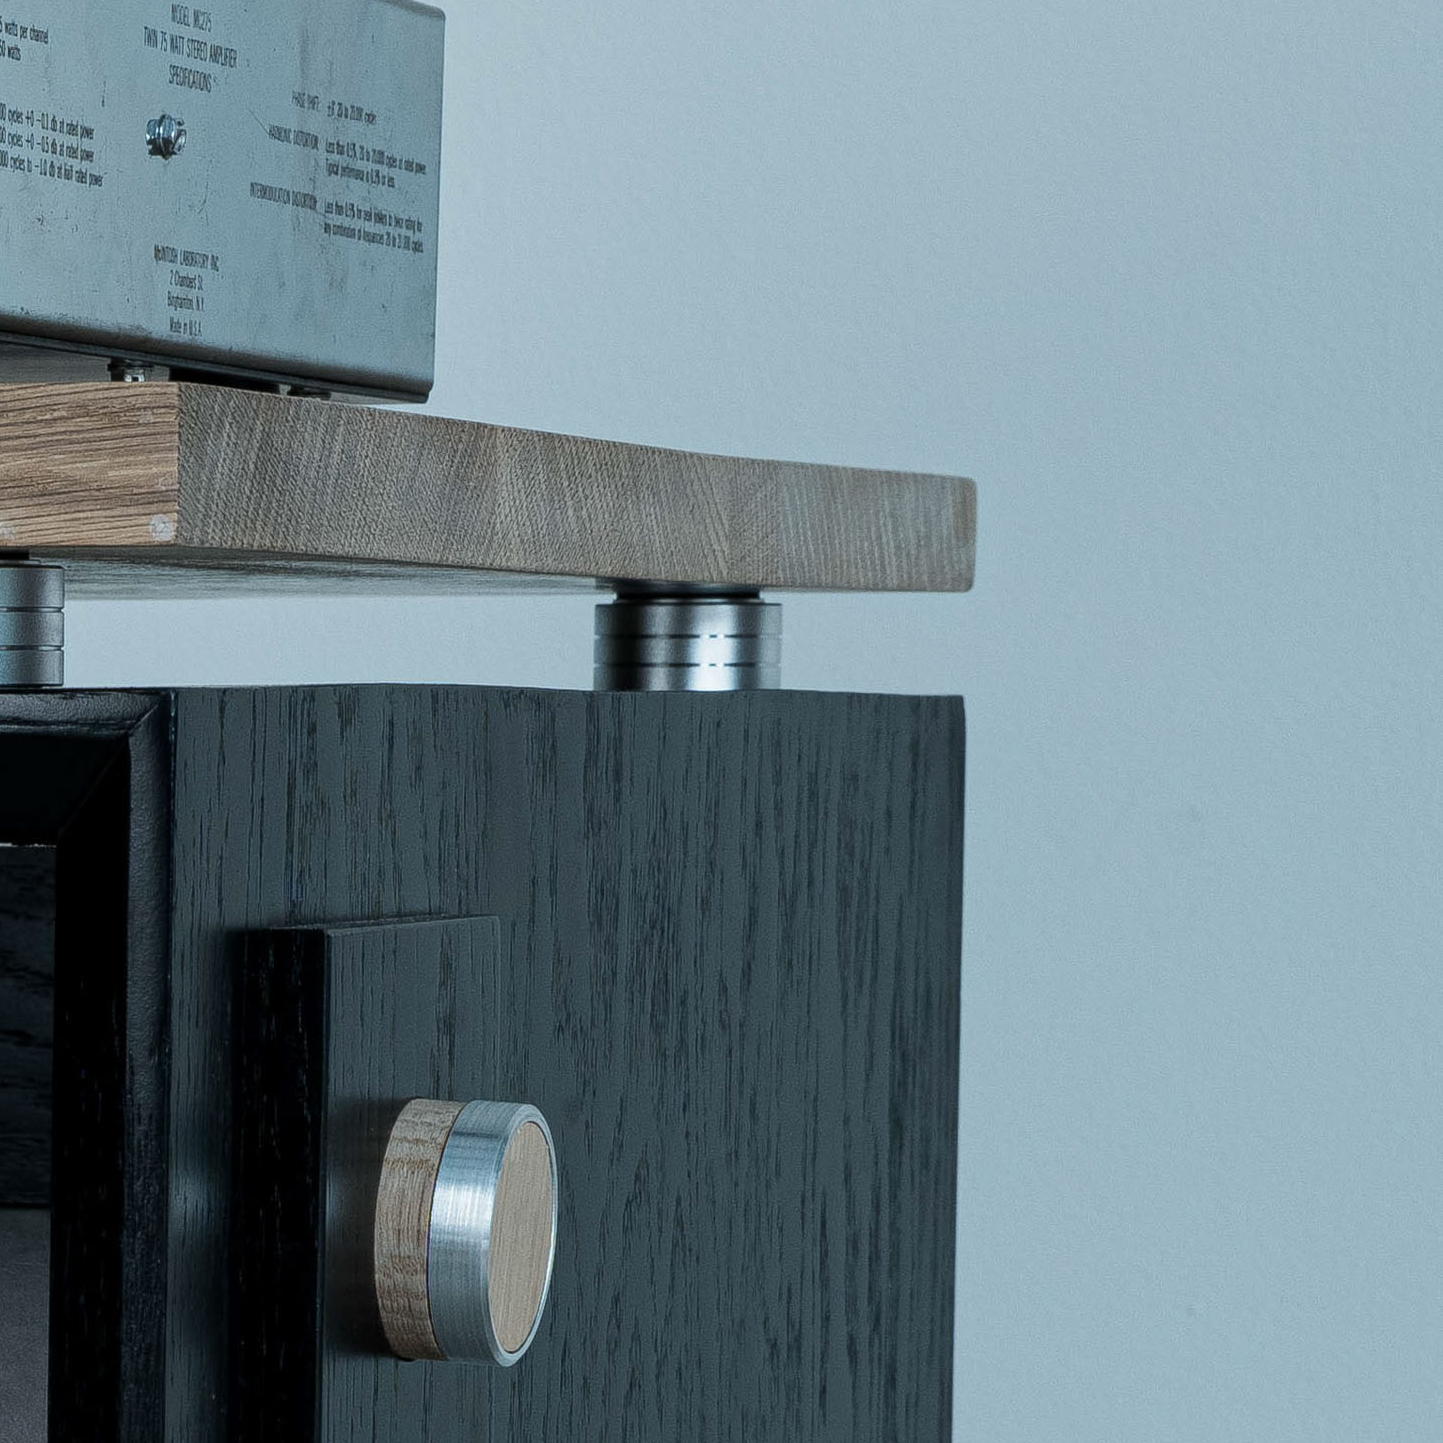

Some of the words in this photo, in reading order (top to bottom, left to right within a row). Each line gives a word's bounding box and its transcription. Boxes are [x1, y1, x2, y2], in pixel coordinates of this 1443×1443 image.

[171, 4, 190, 27] MODEL
[4, 22, 18, 37] watts
[19, 25, 28, 40] per
[29, 25, 49, 44] channel
[7, 44, 22, 61] watts
[144, 26, 158, 49] TWIN
[160, 30, 168, 52] 75
[169, 33, 185, 56] WATT
[186, 37, 207, 62] STEREO
[209, 43, 237, 69] AMPLIFIER
[168, 64, 212, 93] SPECIFICATIONS
[8, 105, 23, 125] cycles
[80, 125, 94, 140] power
[8, 129, 23, 149] cycles
[10, 154, 26, 172] cycles
[89, 172, 103, 188] power
